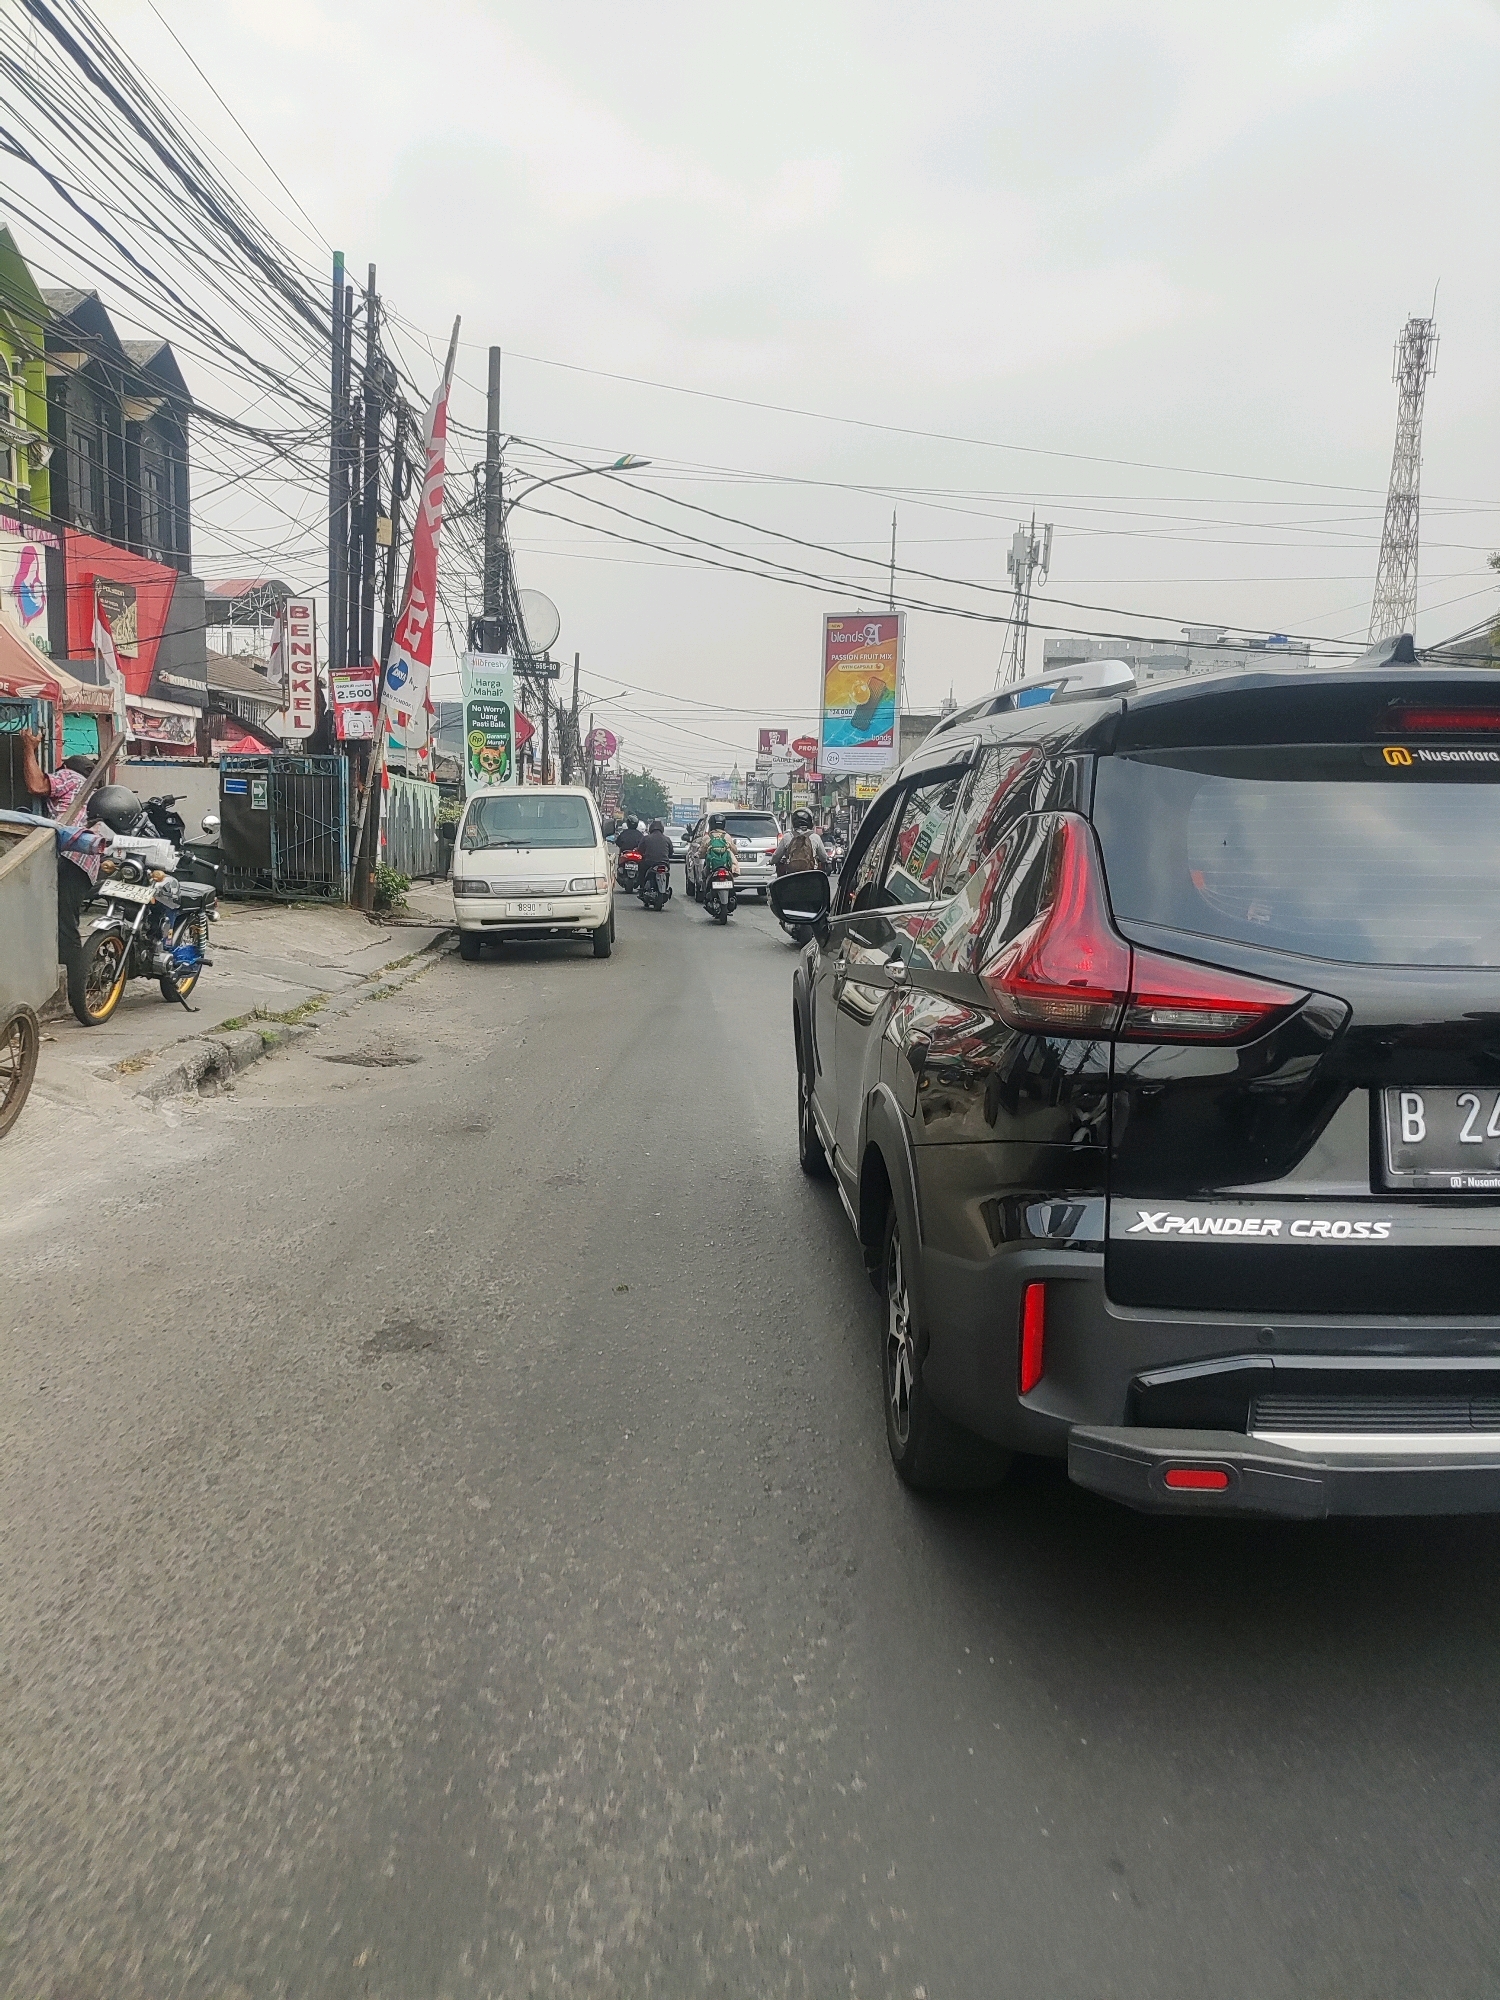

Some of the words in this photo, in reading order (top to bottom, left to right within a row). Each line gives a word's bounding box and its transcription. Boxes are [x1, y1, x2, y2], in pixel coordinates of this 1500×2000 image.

[831, 631, 864, 643] blends
[289, 605, 313, 729] BENGKEL
[475, 678, 500, 688] Harga
[337, 689, 372, 699] 2.500
[473, 687, 504, 697] Mahal?
[482, 705, 505, 713] Worry!
[480, 713, 498, 721] Uang
[472, 735, 481, 743] Rp
[1400, 1092, 1426, 1143] B
[1126, 1211, 1282, 1237] XPANDER
[1290, 1220, 1391, 1239] CROSS
